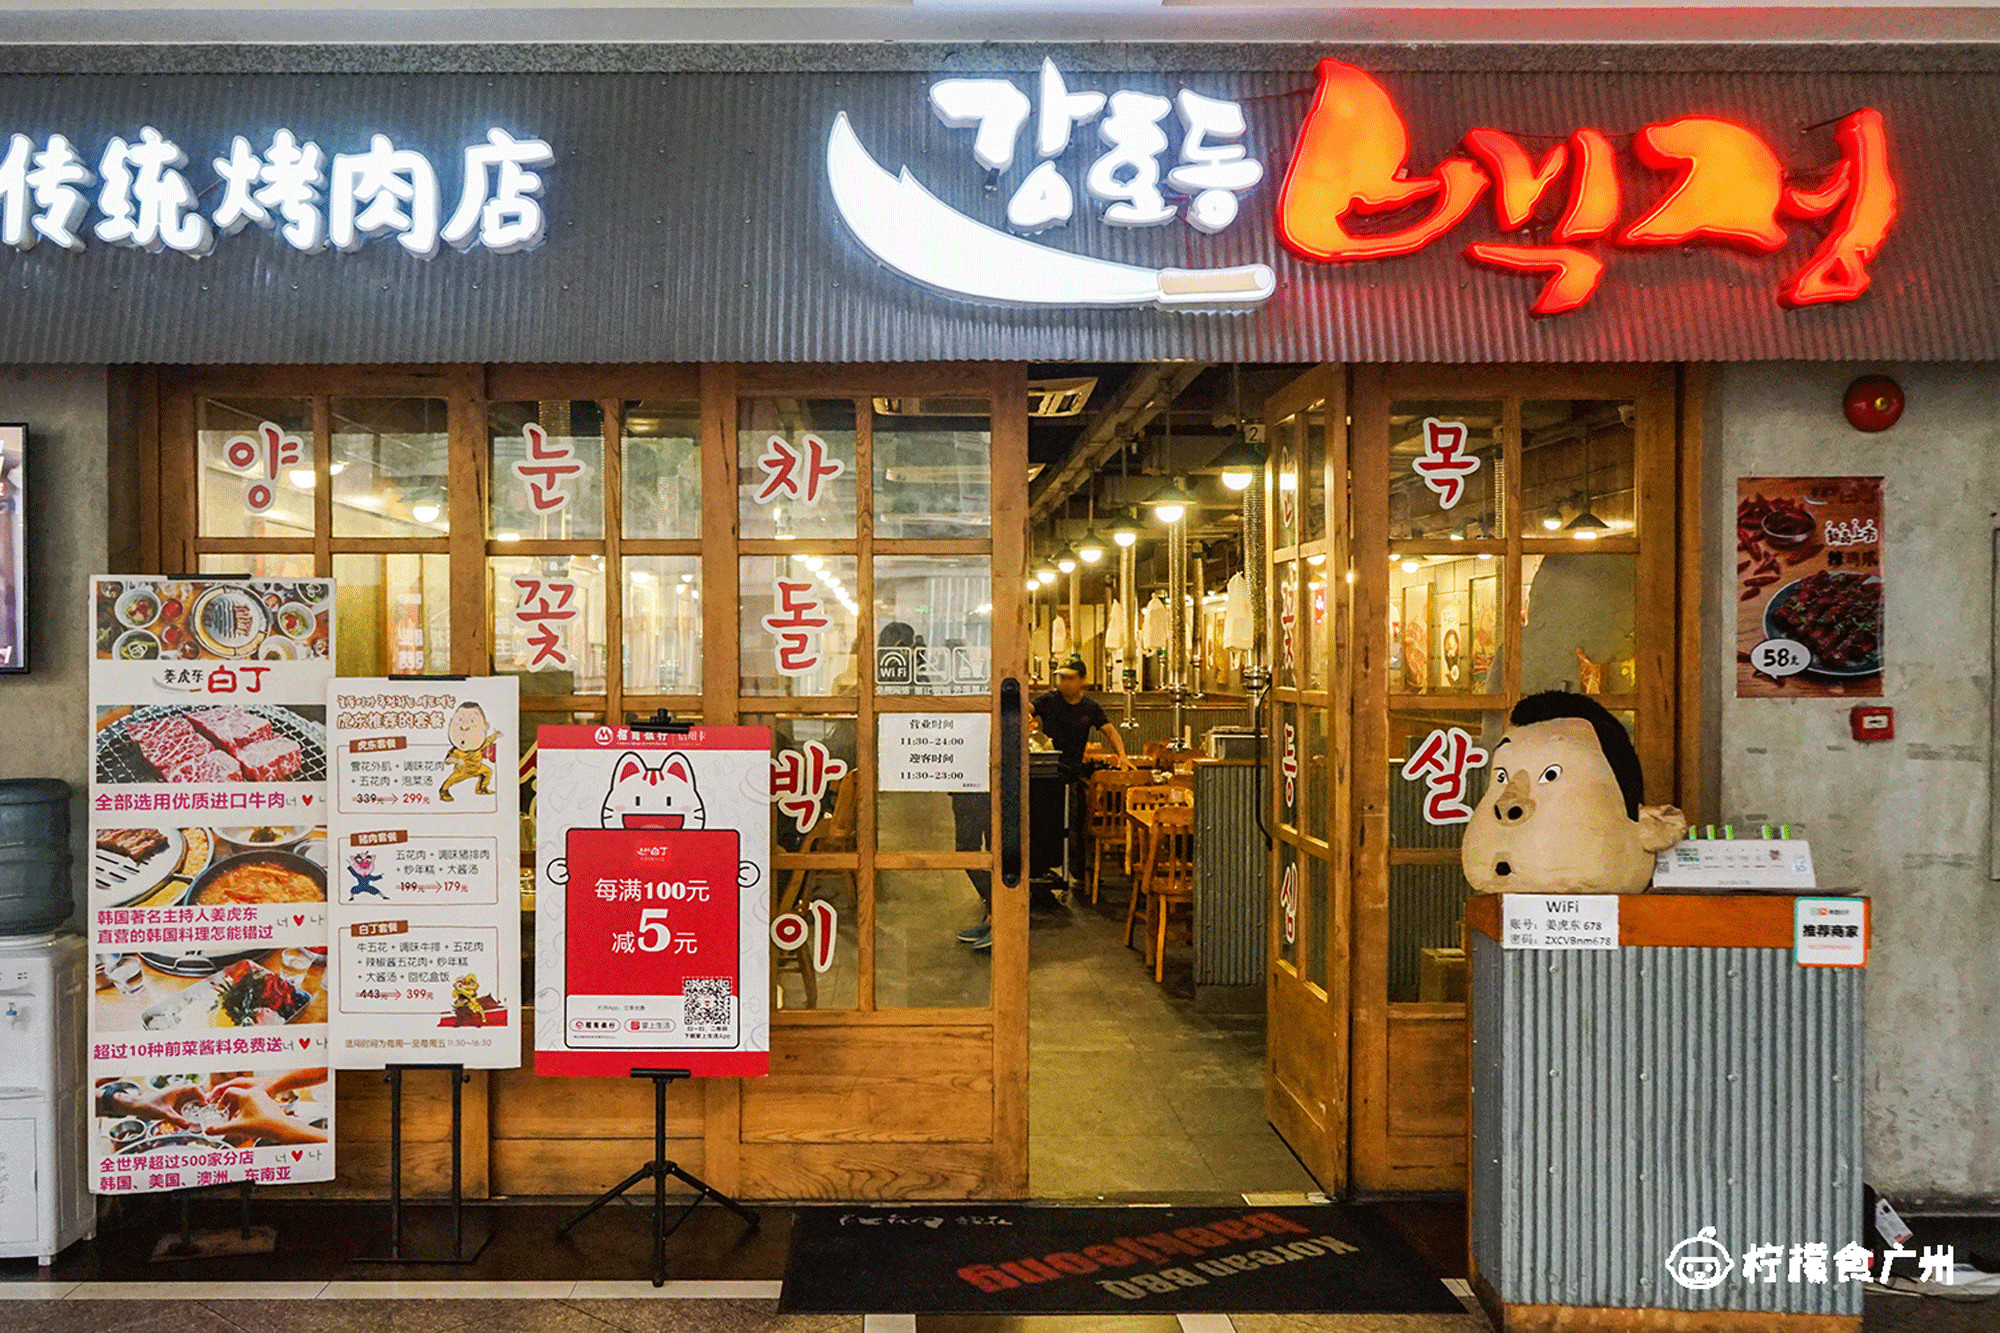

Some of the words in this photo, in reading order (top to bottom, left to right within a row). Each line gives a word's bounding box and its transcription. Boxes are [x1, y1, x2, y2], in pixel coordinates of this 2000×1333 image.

[0, 126, 556, 258] 传统烤肉店
[927, 56, 1265, 235] 강호동
[1277, 57, 1899, 316] 백정
[223, 421, 305, 513] 양
[207, 665, 271, 693] 白丁
[336, 711, 445, 729] 虎东推荐的套餐
[909, 719, 954, 729] 营业时间
[900, 737, 964, 746] 11:30-24:00
[900, 771, 964, 780] 11:30-23:00
[95, 791, 285, 812] 全部选用优质进口牛肉
[594, 878, 711, 902] 每满100元
[97, 907, 258, 925] 韩国著名主持人姜虎东
[1545, 900, 1580, 913] WiFi
[97, 925, 274, 944] 直营的韩国料理怎能错过
[611, 908, 698, 954] 减5元
[1583, 921, 1602, 931] 678
[1803, 925, 1859, 938] 推荐商家
[93, 1036, 283, 1060] 超过10种前菜酱料免费送
[100, 1150, 254, 1174] 全世界超过500家分店
[1199, 1234, 1360, 1277] Korean
[1095, 1267, 1209, 1300] BBQ
